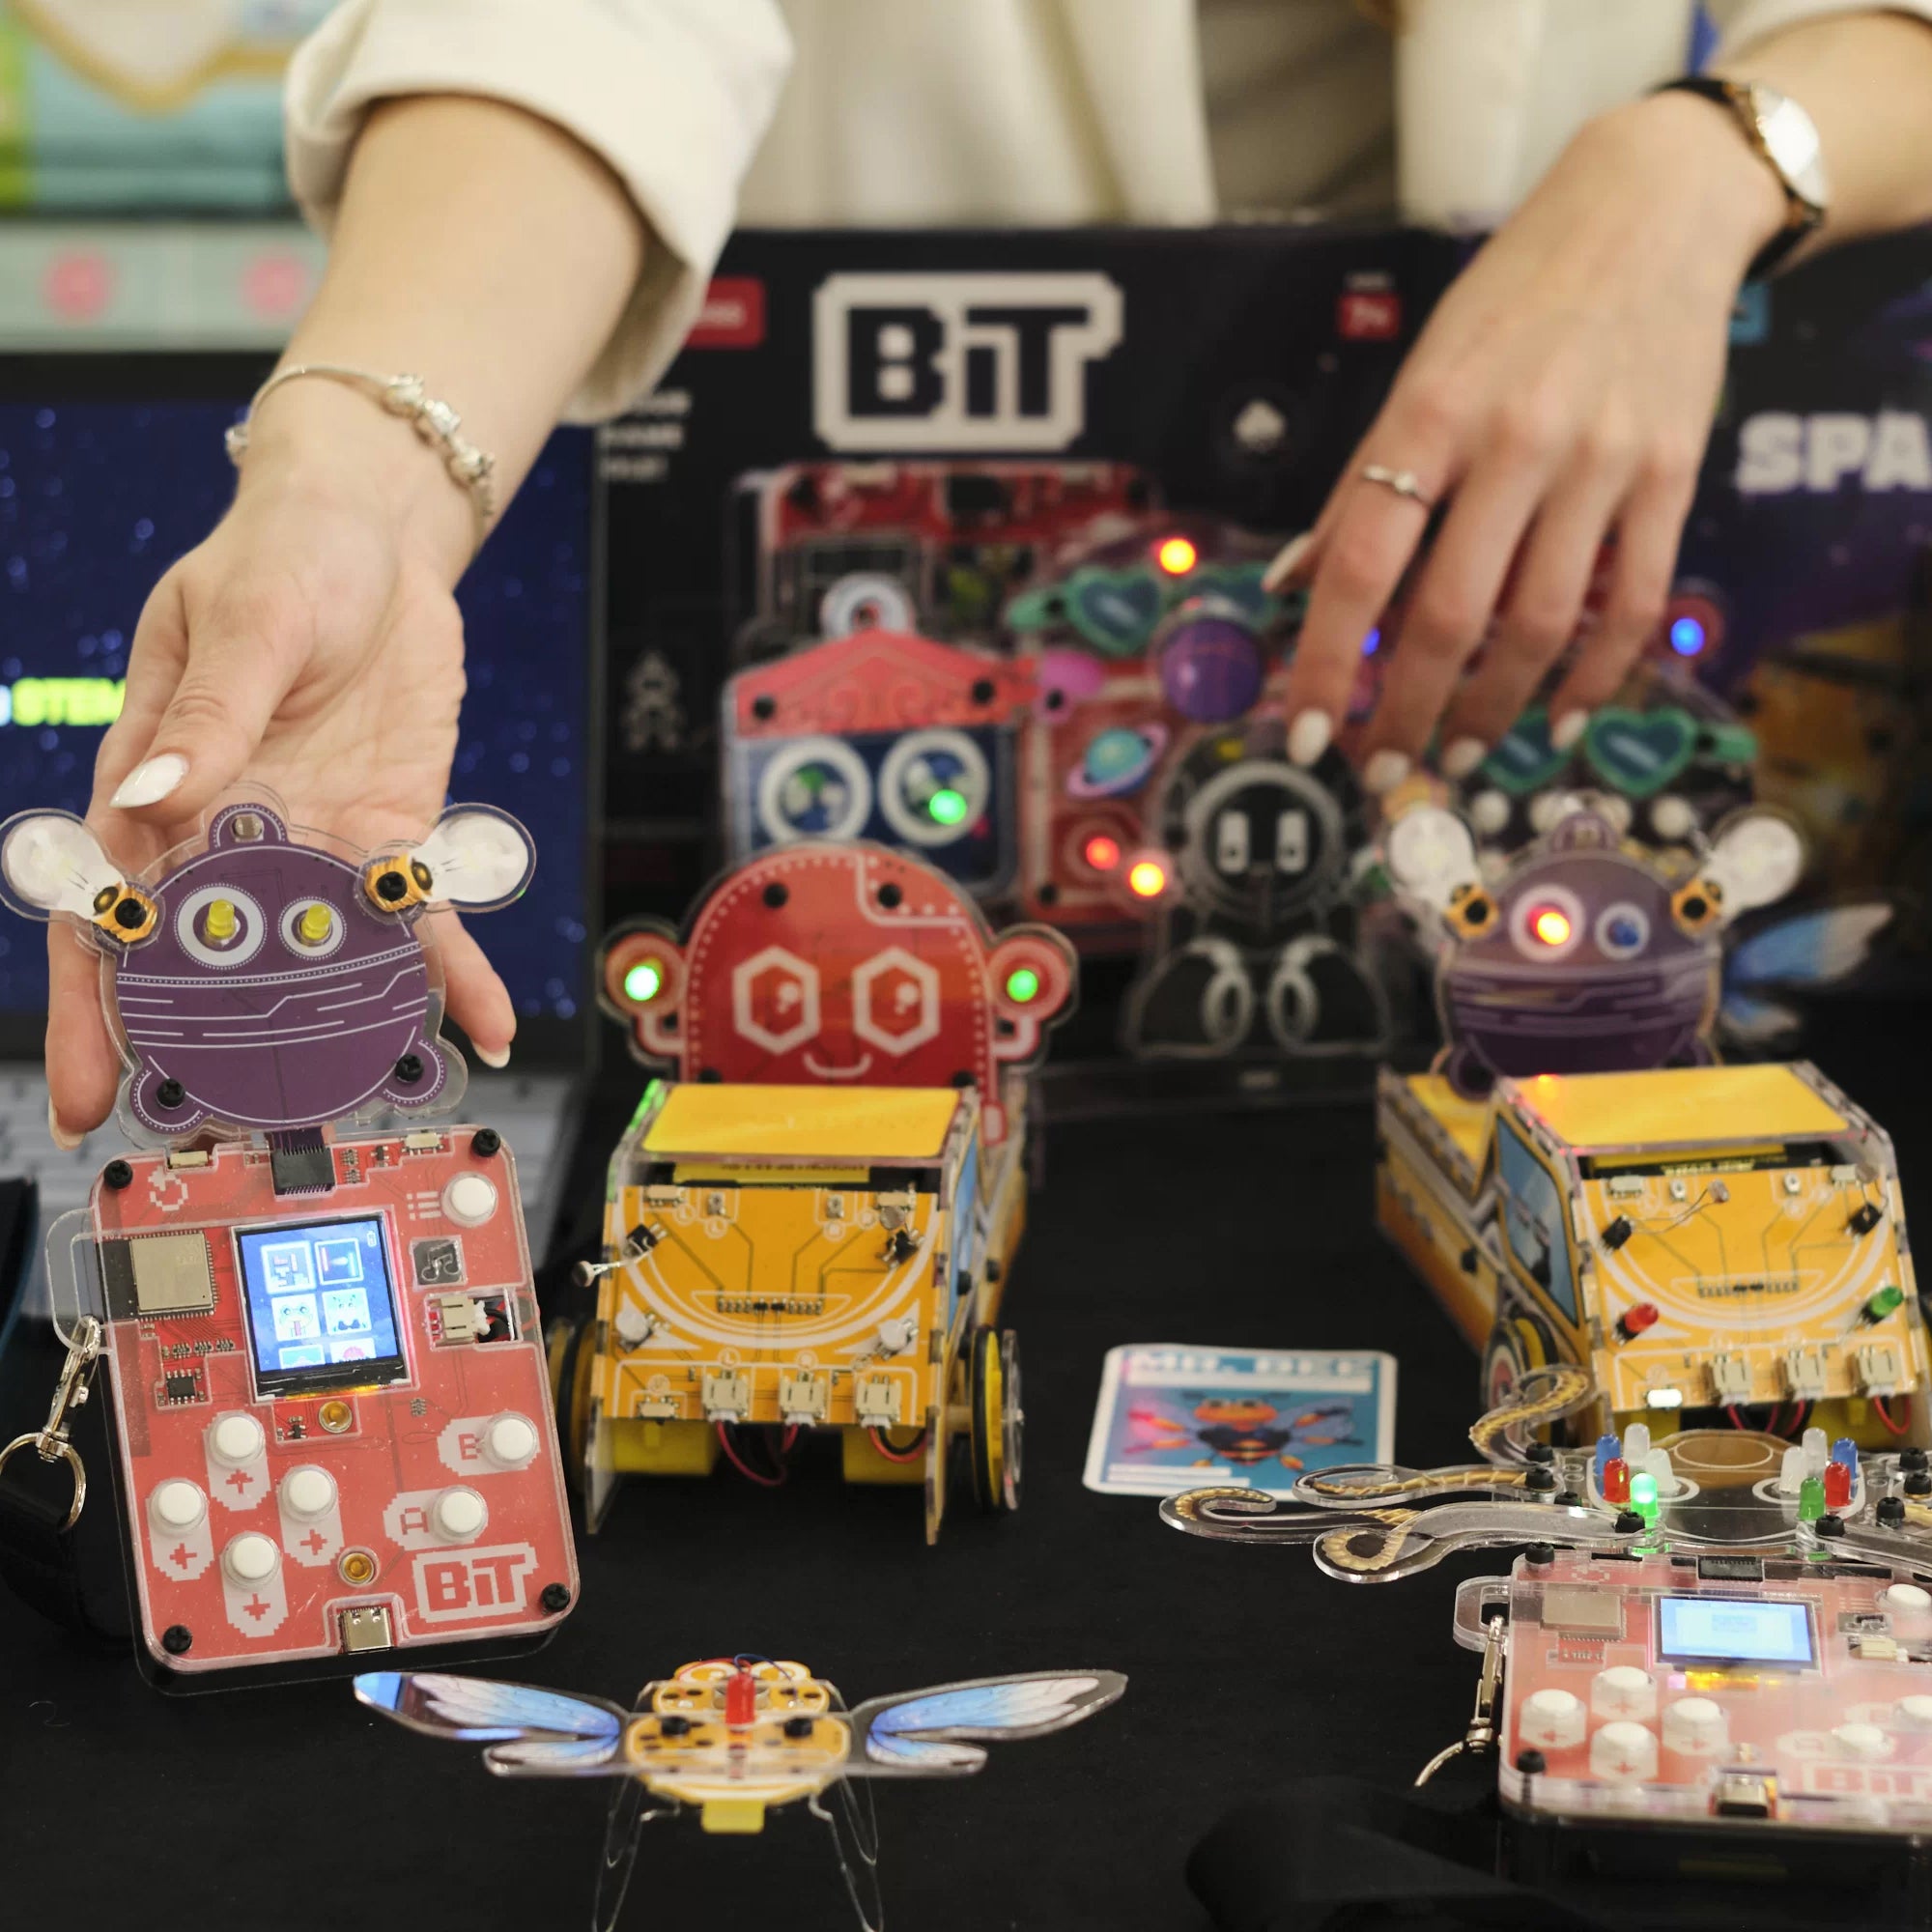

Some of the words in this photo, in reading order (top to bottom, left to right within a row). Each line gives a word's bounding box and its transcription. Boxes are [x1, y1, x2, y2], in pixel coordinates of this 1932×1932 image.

[1735, 411, 1932, 494] SPA
[458, 1433, 482, 1461] B
[400, 1507, 429, 1535] A
